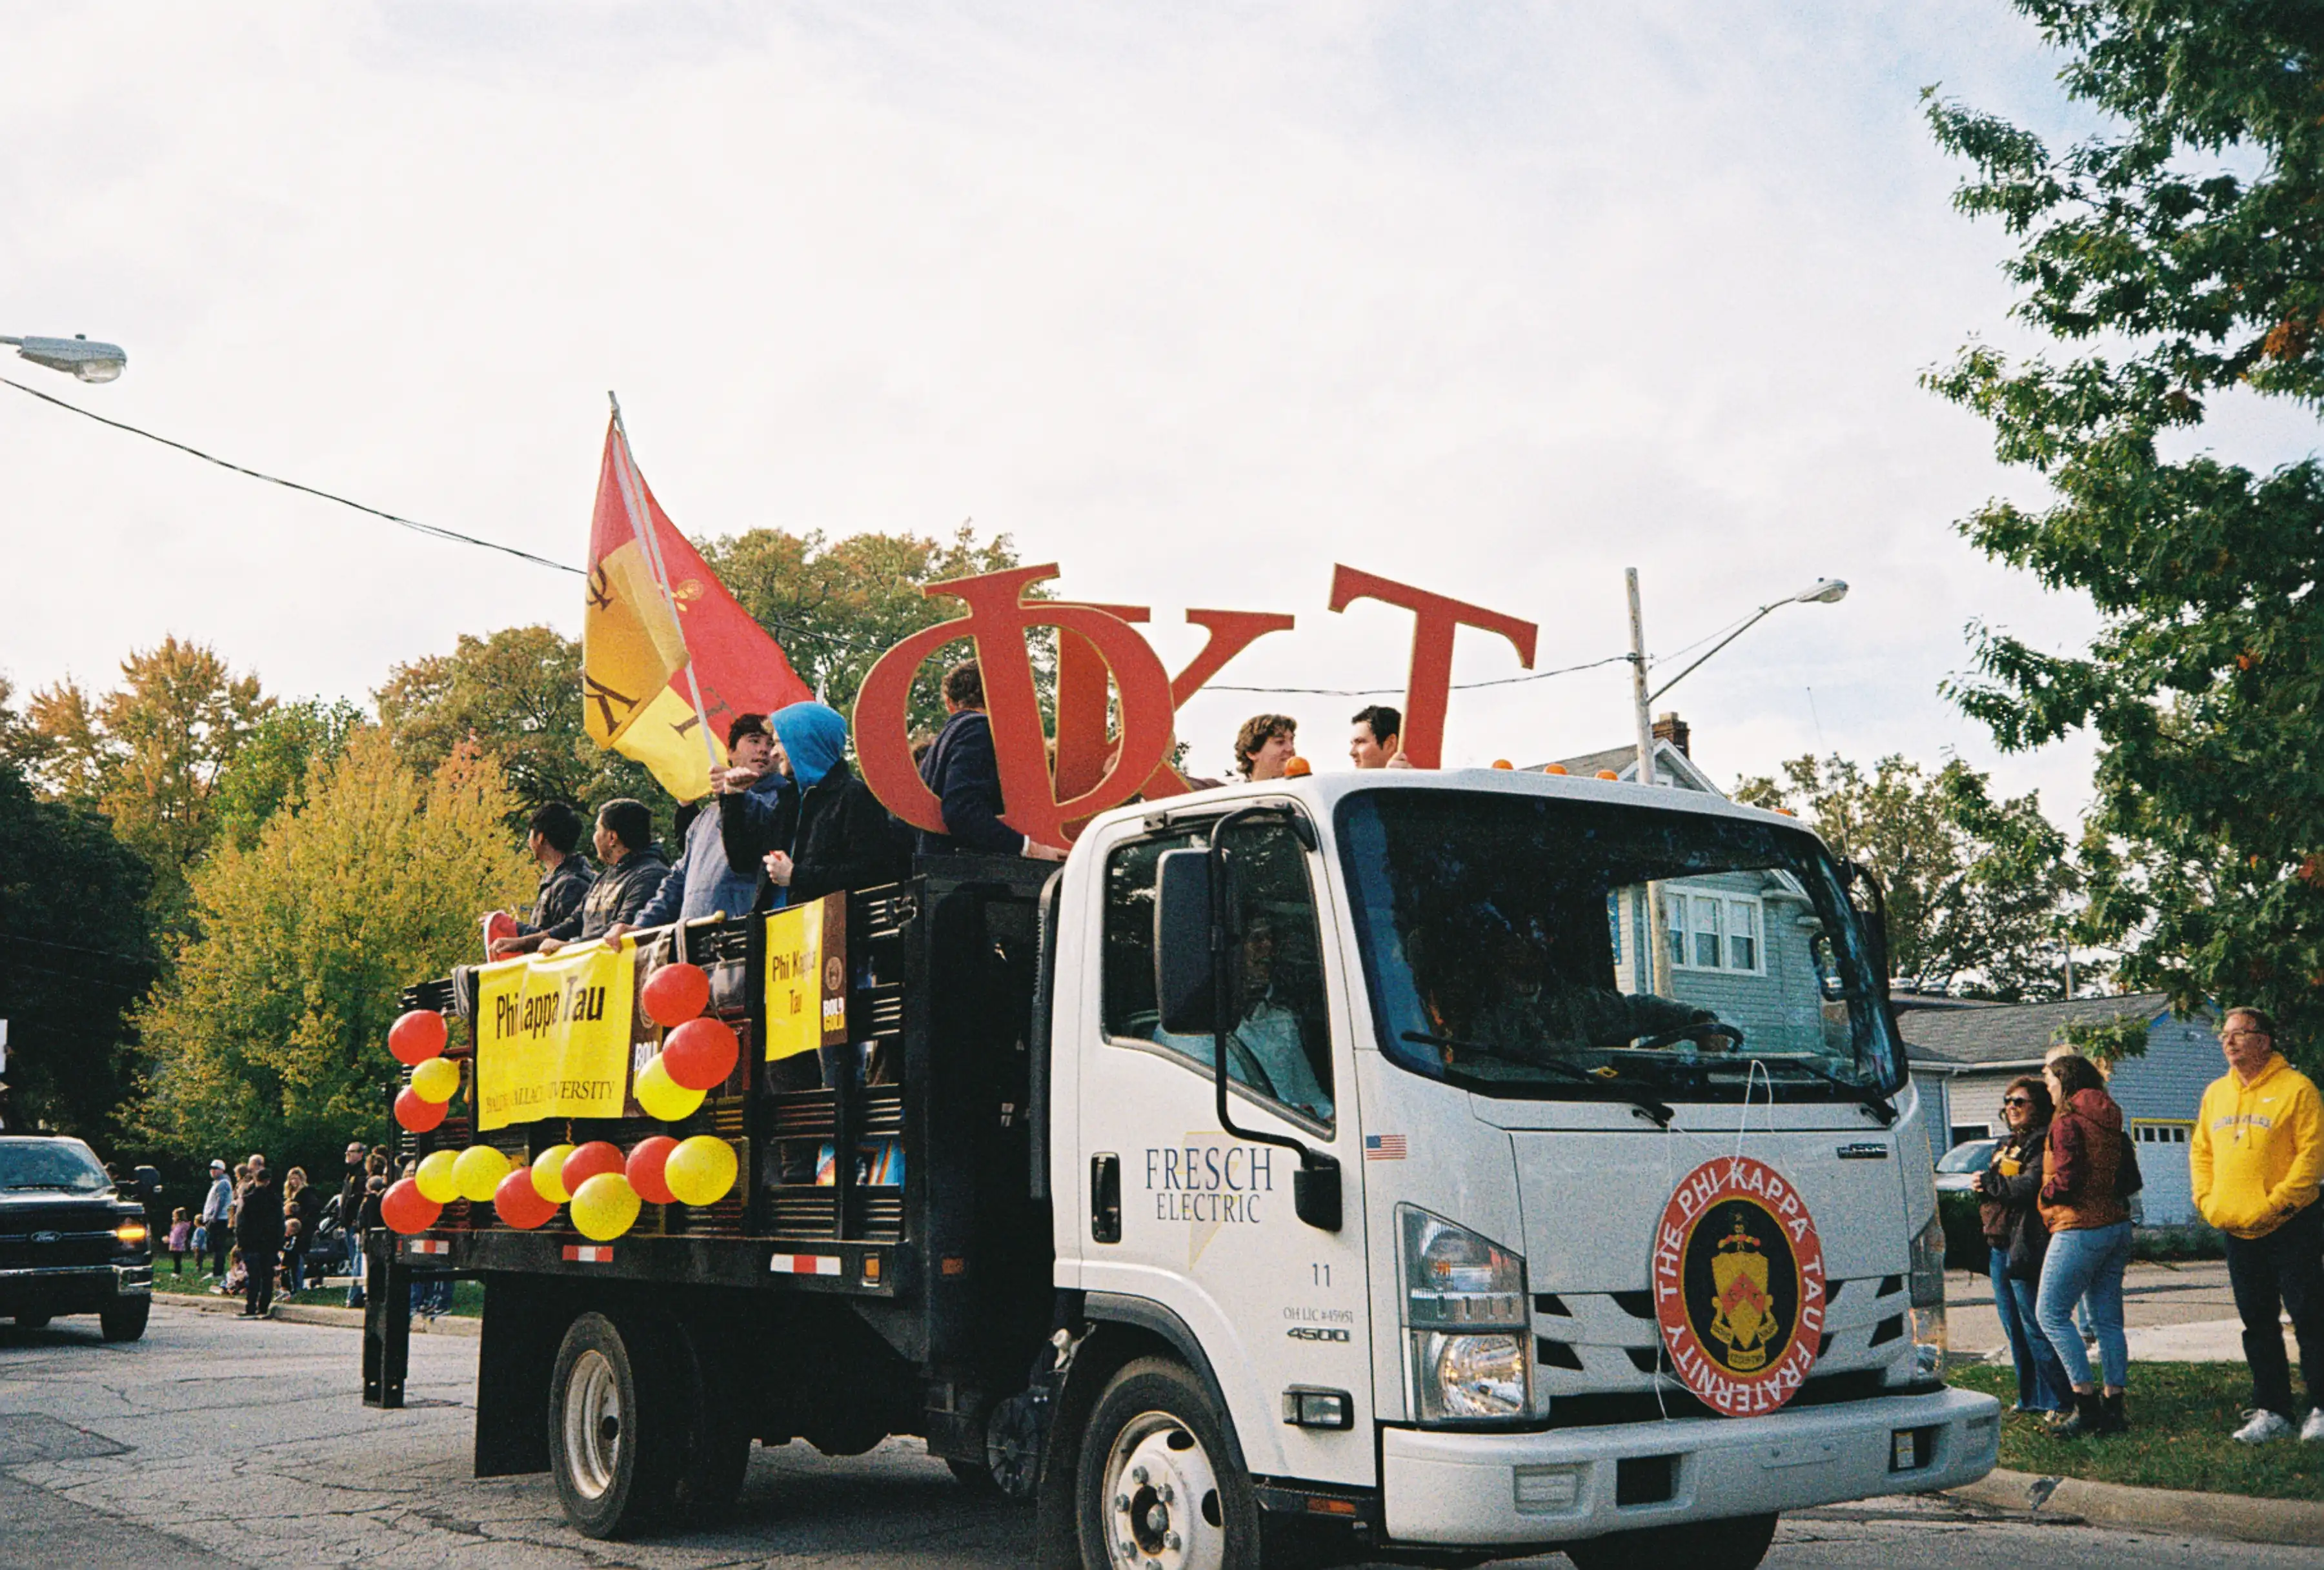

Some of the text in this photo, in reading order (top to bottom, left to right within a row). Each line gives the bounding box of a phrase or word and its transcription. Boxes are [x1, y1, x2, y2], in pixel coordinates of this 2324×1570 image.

[772, 954, 789, 982] Phi
[496, 975, 605, 1040] Phi appa Tau
[823, 996, 844, 1018] BOLD
[1145, 1147, 1273, 1191] FRESCH
[1156, 1193, 1261, 1223] ELECTRIC
[1678, 1168, 1719, 1217] PHI
[1730, 1162, 1809, 1243] KAPPA
[1311, 1262, 1330, 1288] 11
[1659, 1222, 1684, 1303] THE
[1282, 1306, 1300, 1320] OH
[1802, 1254, 1823, 1331] TAU
[1286, 1326, 1351, 1342] 4500
[1666, 1324, 1812, 1412] FRATERNITY
